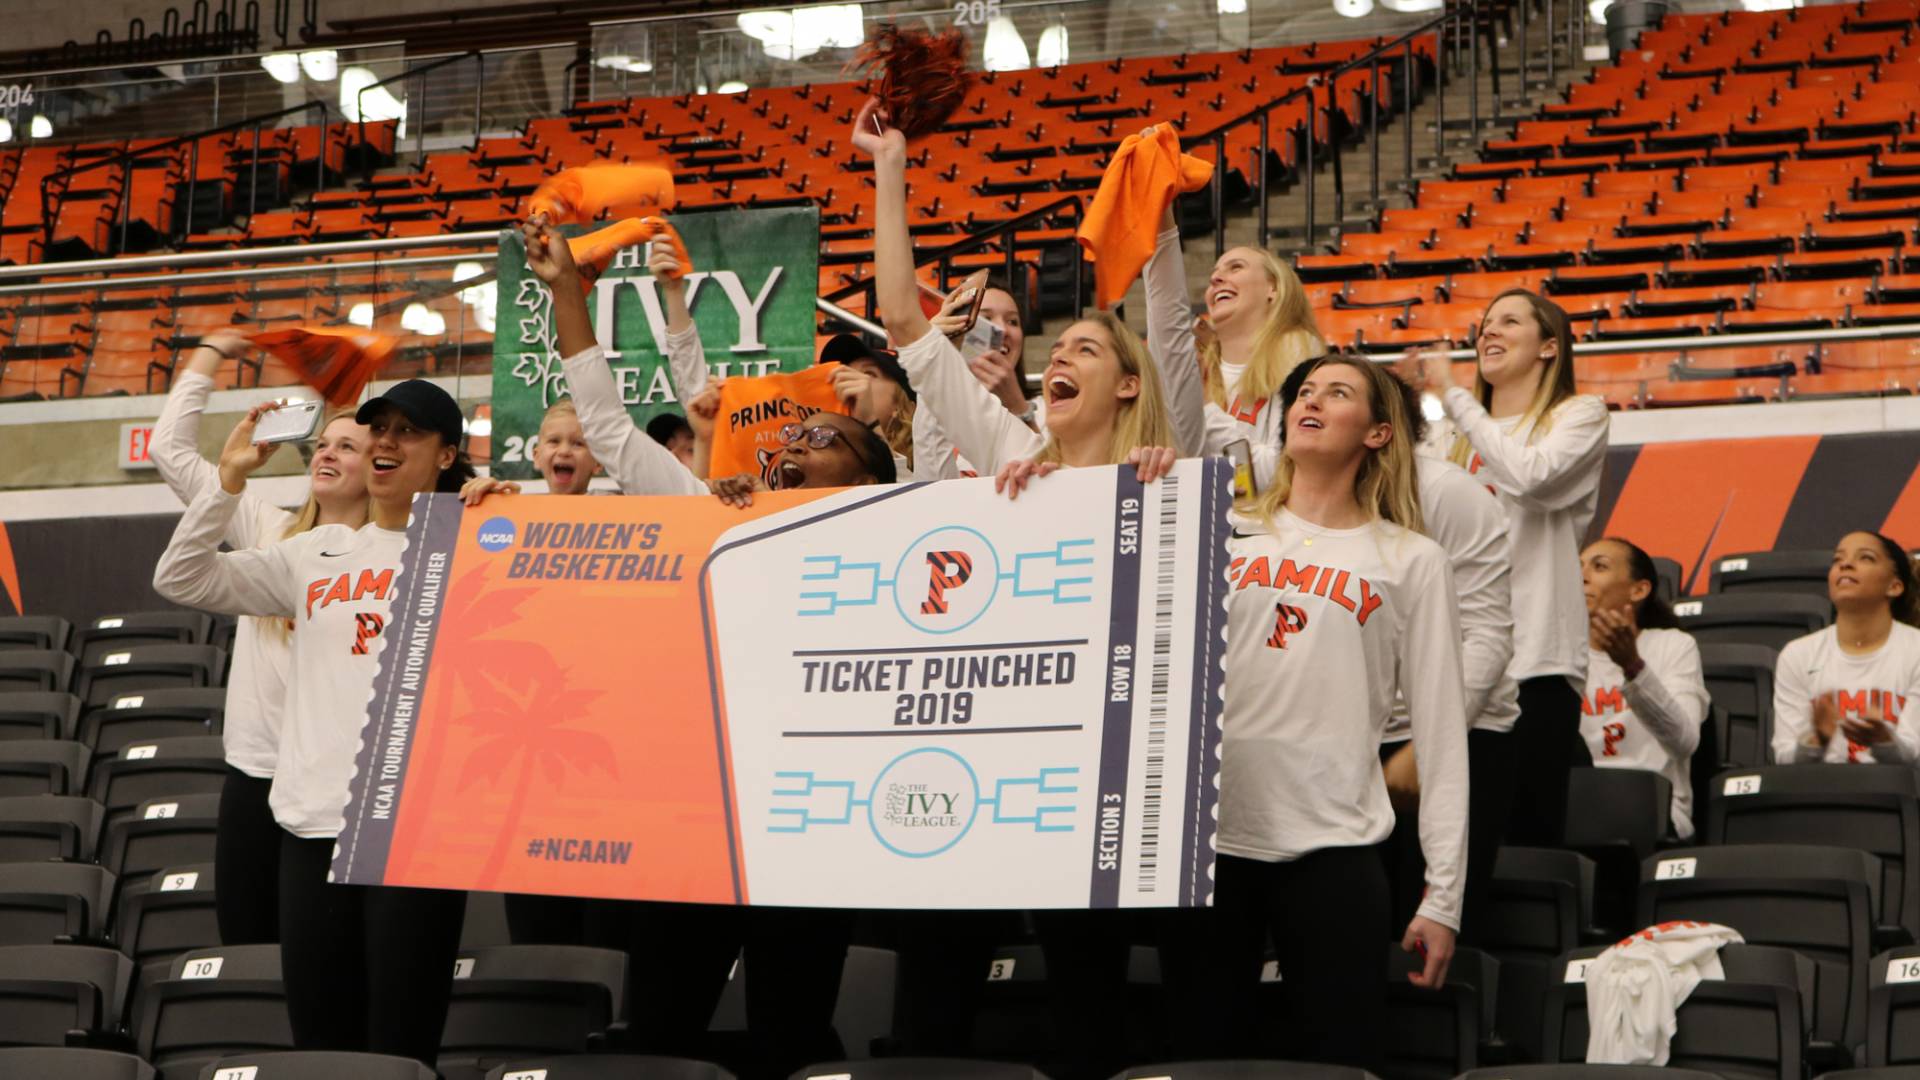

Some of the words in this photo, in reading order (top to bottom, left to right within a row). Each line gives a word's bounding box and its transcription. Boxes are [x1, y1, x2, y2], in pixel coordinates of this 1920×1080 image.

[0, 84, 34, 108] 204
[594, 266, 784, 359] IVY
[1121, 499, 1139, 514] 19
[479, 533, 514, 544] NCAA
[522, 522, 662, 550] WOMEN'S
[1120, 521, 1138, 555] SEAT
[507, 552, 684, 582] BASKETBALL
[306, 568, 393, 621] FAM
[417, 551, 447, 617] QUALIFIER
[920, 551, 973, 614] P
[351, 612, 384, 655] P
[1266, 602, 1308, 650] P
[401, 618, 433, 691] AUTOMATIC
[1114, 644, 1132, 661] 18
[802, 659, 913, 693] TICKET
[922, 652, 1077, 690] PUNCHED
[1111, 672, 1130, 702] ROW
[894, 692, 974, 726] 2019
[381, 694, 416, 780] TOURNAMENT
[372, 783, 396, 819] NCAA
[907, 784, 929, 793] THE
[1103, 793, 1122, 804] 3
[1736, 779, 1752, 794] 15
[904, 793, 960, 815] IVY
[526, 838, 633, 864] #NCAAW
[1099, 807, 1121, 870] SECTION
[176, 877, 185, 890] 9
[1668, 863, 1687, 878] 15
[195, 962, 213, 977] 10
[1902, 961, 1920, 978] 16
